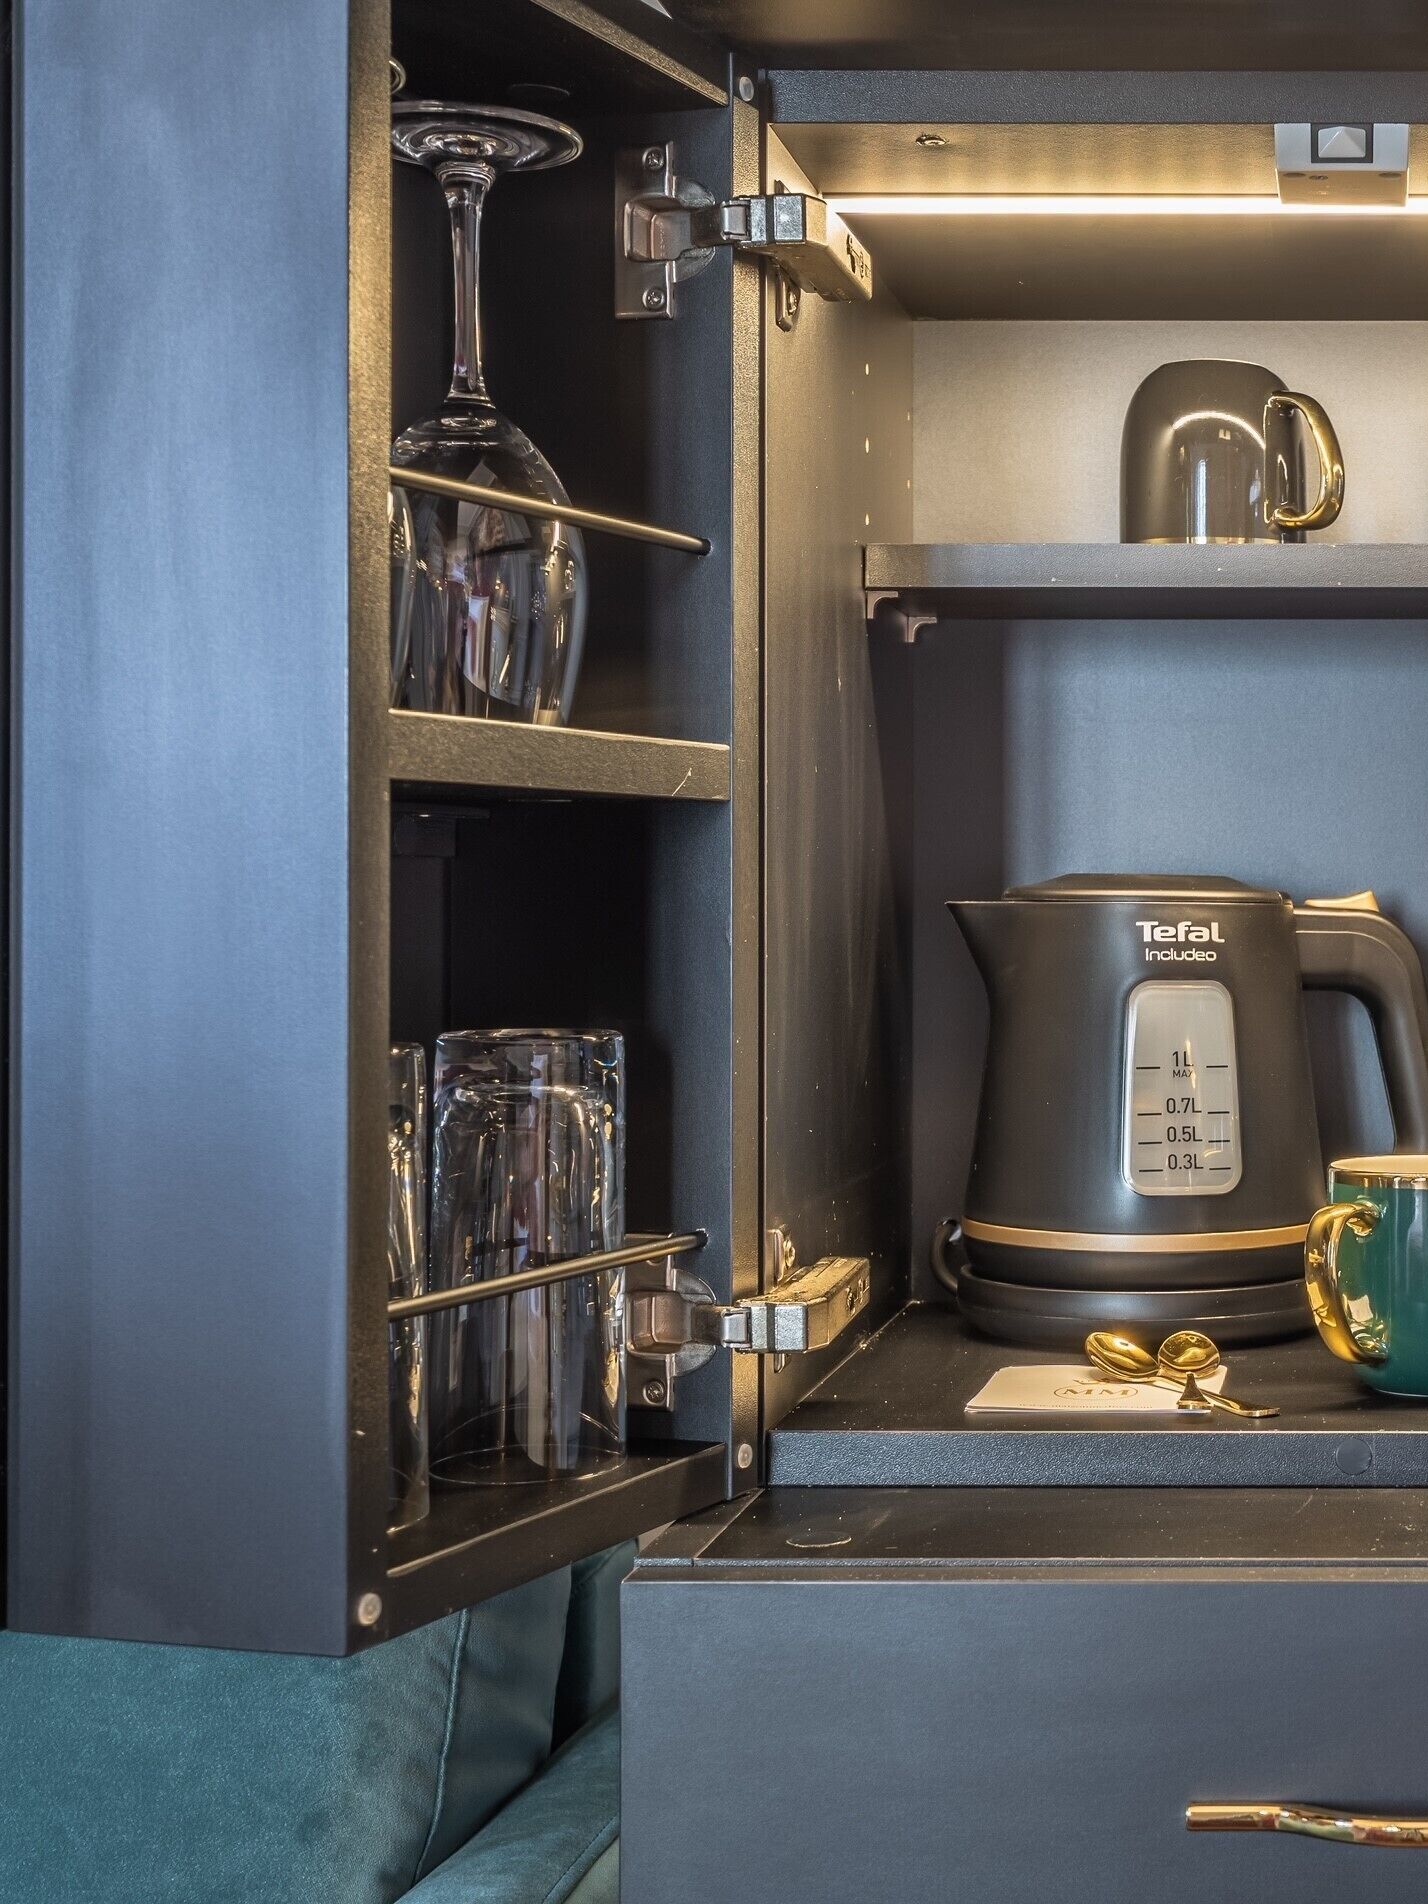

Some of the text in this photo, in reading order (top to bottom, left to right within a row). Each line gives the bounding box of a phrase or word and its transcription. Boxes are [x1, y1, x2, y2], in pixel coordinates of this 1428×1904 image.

[1135, 920, 1226, 943] Tefal
[1145, 947, 1217, 962] Includeo
[1166, 1097, 1202, 1114] 0.7L
[1167, 1126, 1203, 1143] 0.5L
[1168, 1153, 1204, 1170] 0.3L
